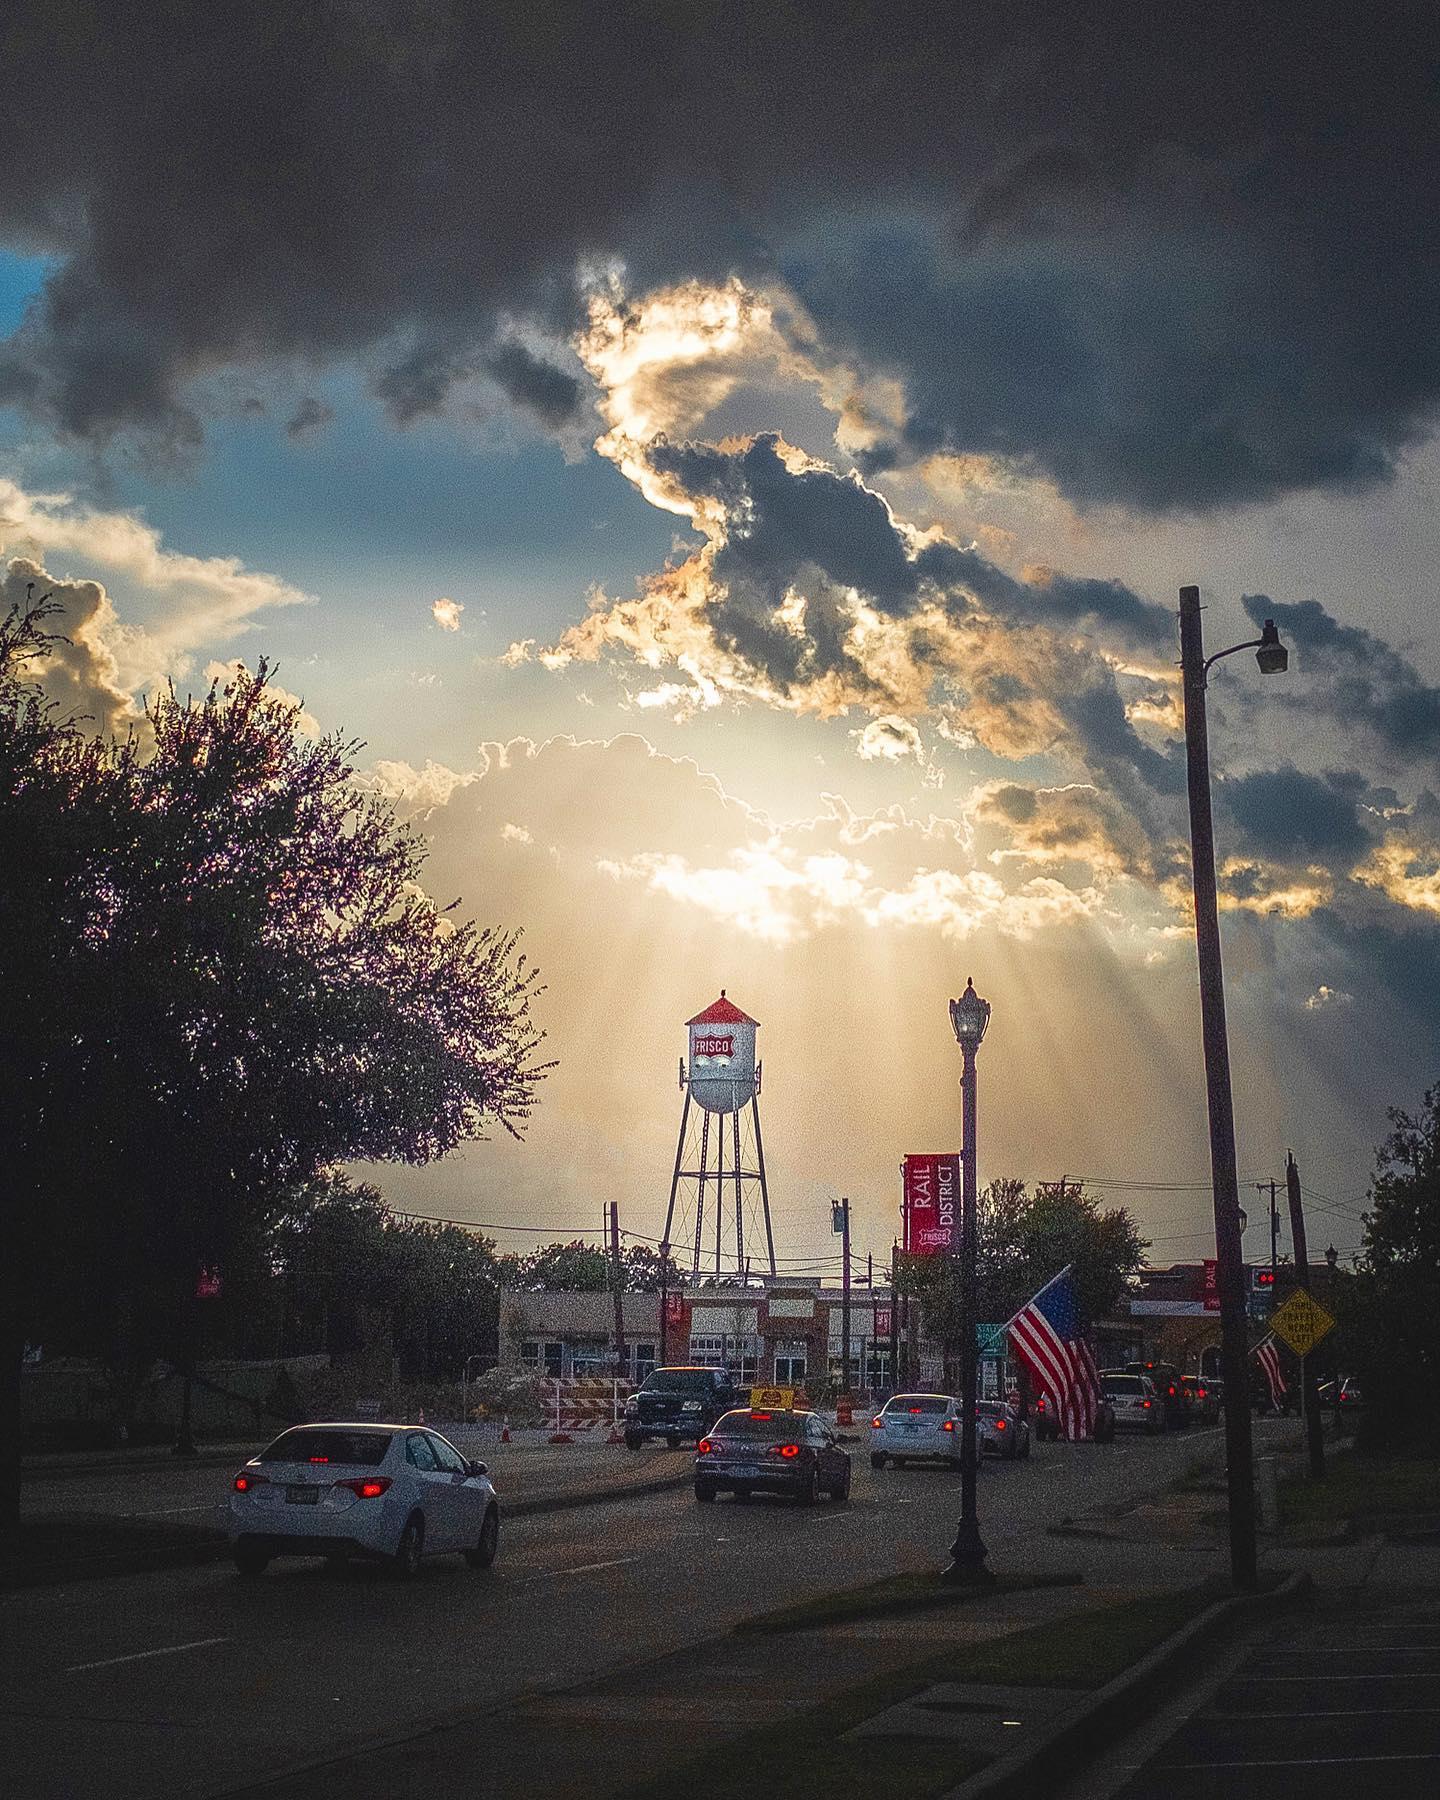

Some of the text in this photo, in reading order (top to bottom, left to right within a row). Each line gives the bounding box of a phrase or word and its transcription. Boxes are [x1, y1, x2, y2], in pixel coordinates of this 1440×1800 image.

[695, 1040, 729, 1053] FRISCO
[913, 1164, 932, 1209] RAIL
[938, 1164, 954, 1226] DISTRICT
[1205, 1264, 1216, 1289] RAIL
